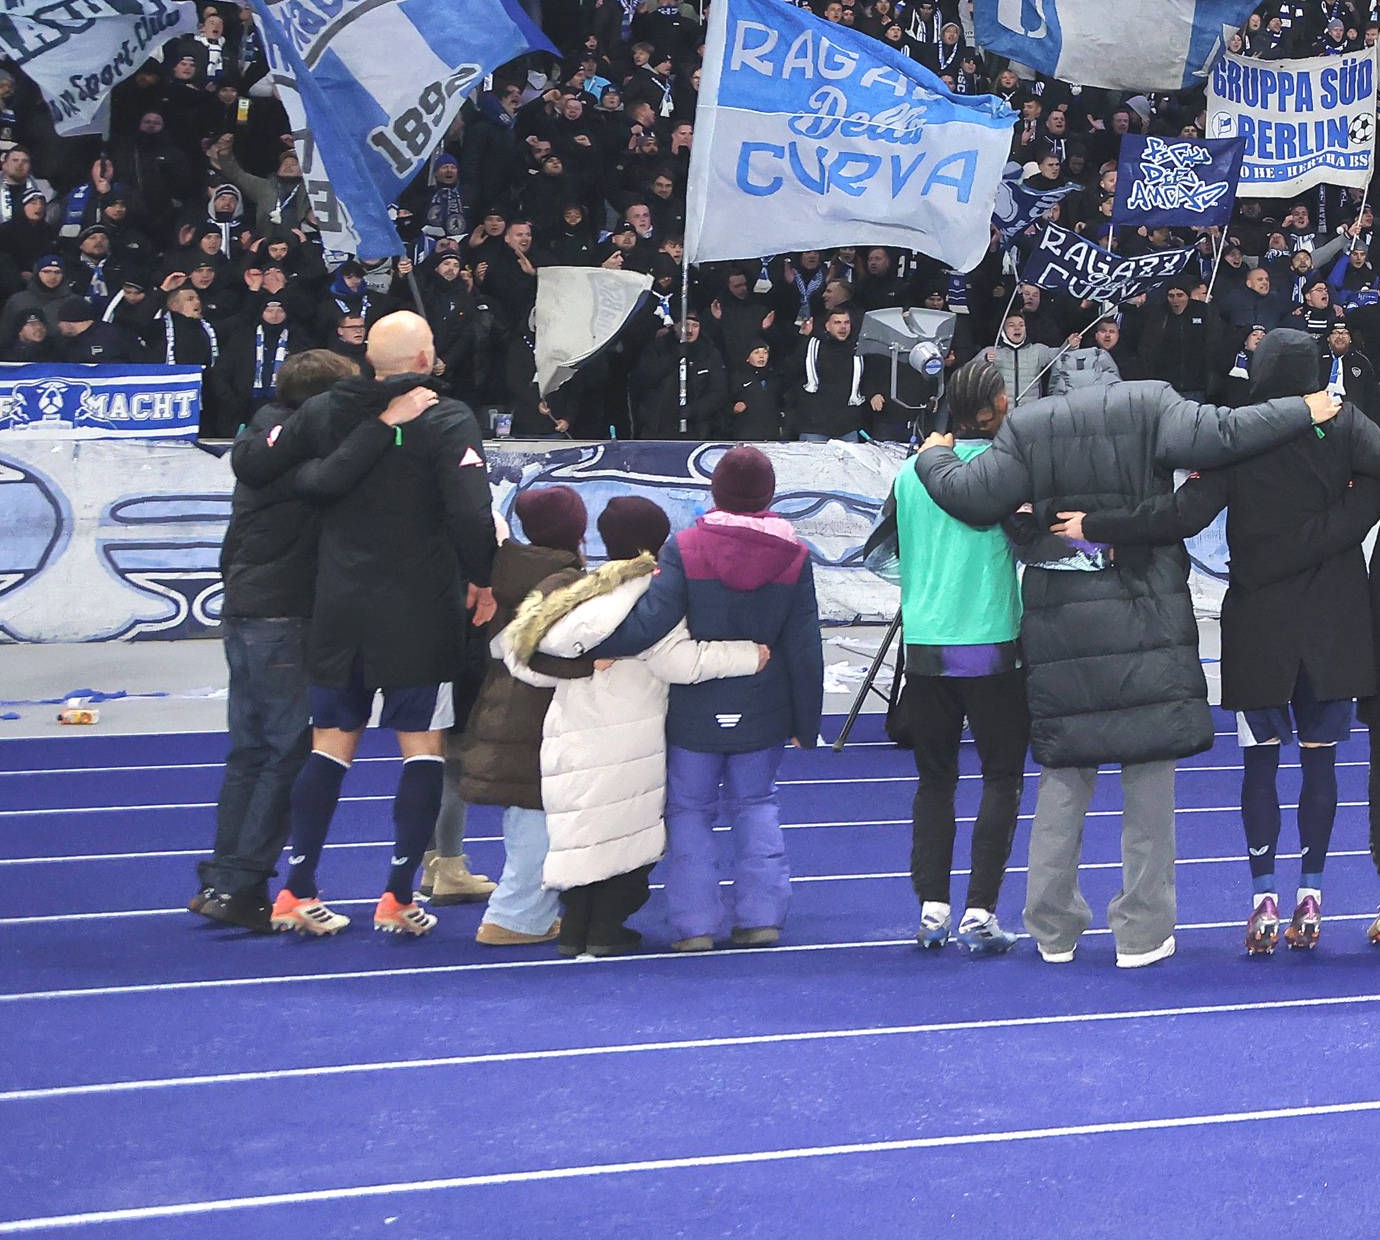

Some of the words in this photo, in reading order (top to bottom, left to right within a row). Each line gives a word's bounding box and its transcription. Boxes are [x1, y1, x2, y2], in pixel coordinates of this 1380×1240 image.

[1213, 61, 1314, 113] GRUPPA
[1320, 57, 1374, 111] SÜD
[372, 64, 480, 172] 1892
[787, 84, 928, 145] Della
[1237, 113, 1350, 161] BERLIN
[735, 140, 979, 204] CURVA
[1254, 166, 1276, 180] HE
[1287, 154, 1347, 179] HERTHA
[1351, 153, 1369, 167] BS
[87, 389, 199, 422] MACHT
